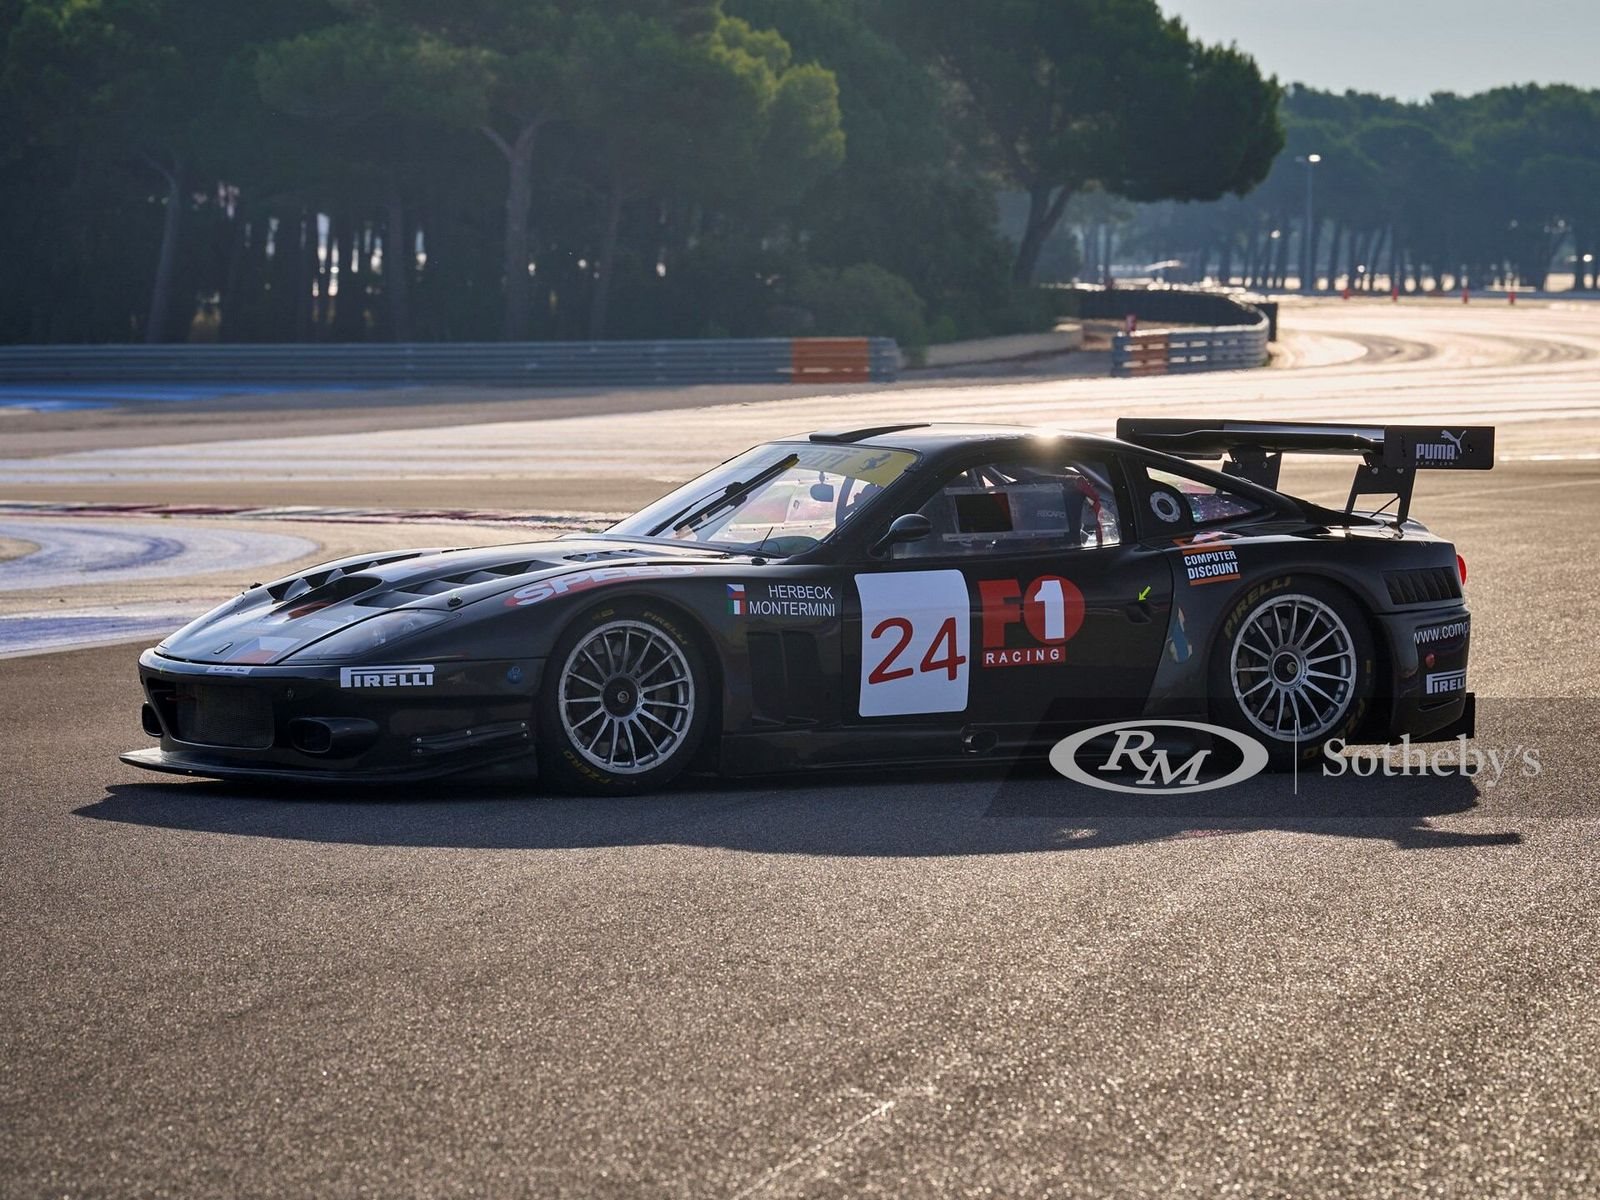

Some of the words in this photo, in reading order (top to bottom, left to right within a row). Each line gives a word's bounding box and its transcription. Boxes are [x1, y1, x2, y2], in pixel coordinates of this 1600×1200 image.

[1416, 443, 1455, 460] PUMA
[1184, 550, 1237, 566] COMPUTER
[1187, 562, 1239, 580] DISCOUNT
[513, 565, 697, 606] SPEED
[768, 584, 834, 600] HERBECK
[749, 600, 835, 617] MONTERMINI
[868, 617, 966, 685] 24
[986, 648, 1060, 664] RACING
[340, 664, 435, 688] PIRELLI
